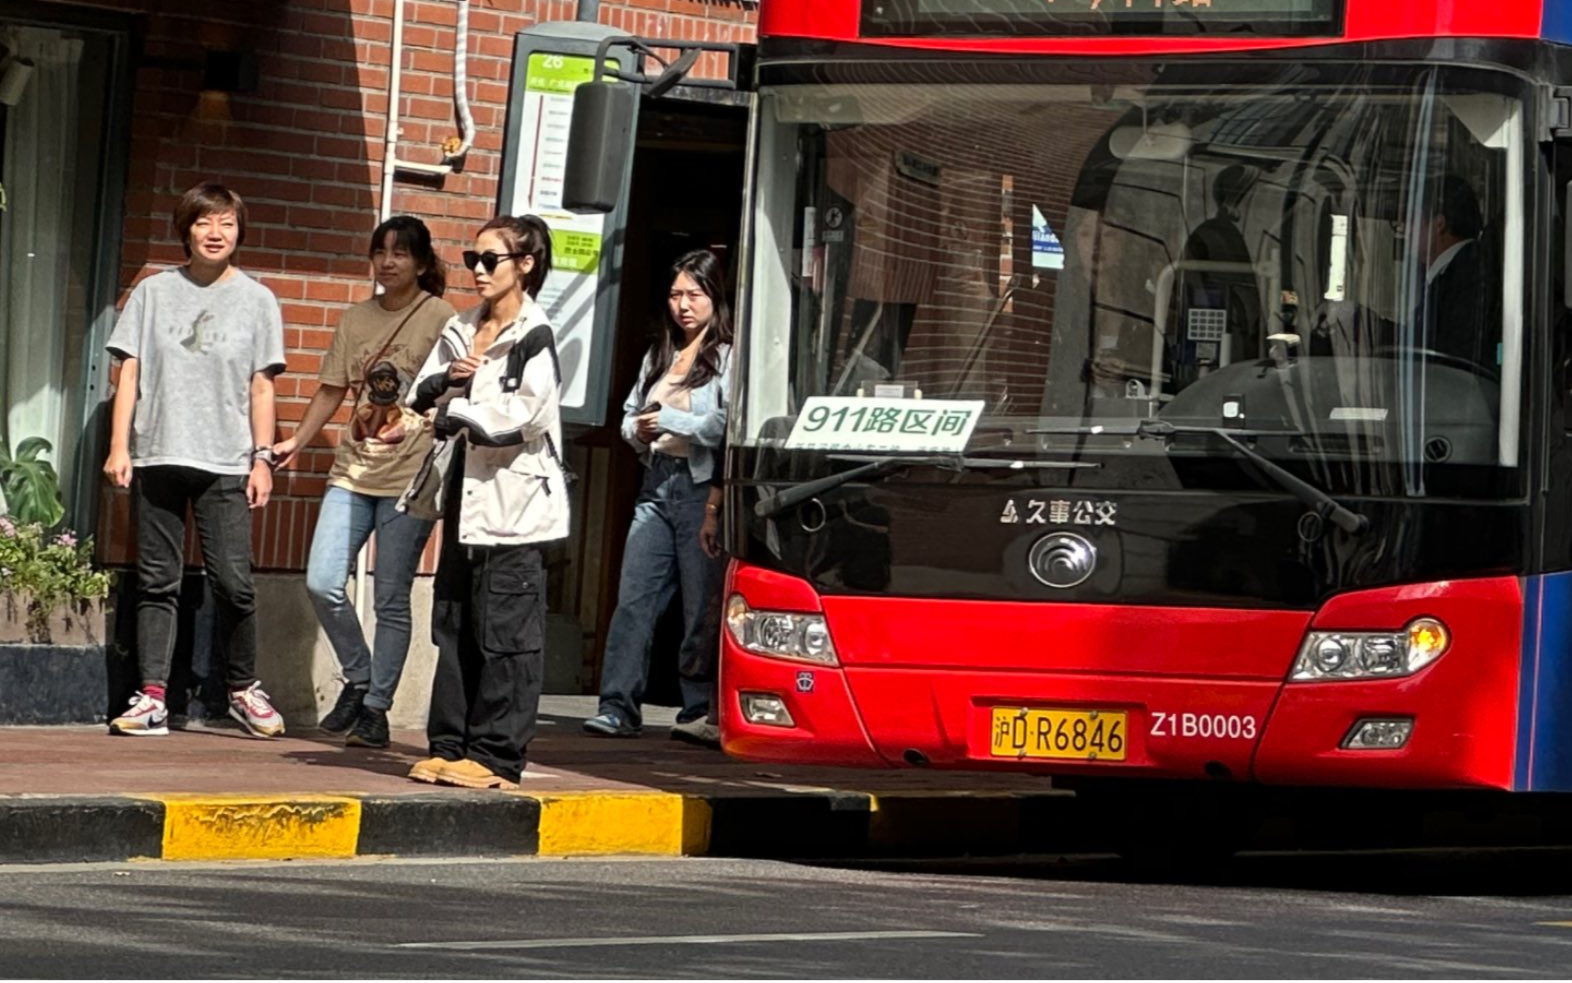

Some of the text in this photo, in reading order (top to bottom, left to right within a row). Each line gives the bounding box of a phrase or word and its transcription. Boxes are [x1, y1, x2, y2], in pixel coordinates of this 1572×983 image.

[803, 406, 972, 436] 911路区间
[1026, 500, 1117, 525] 久事公交
[1150, 712, 1256, 739] Z1B0003
